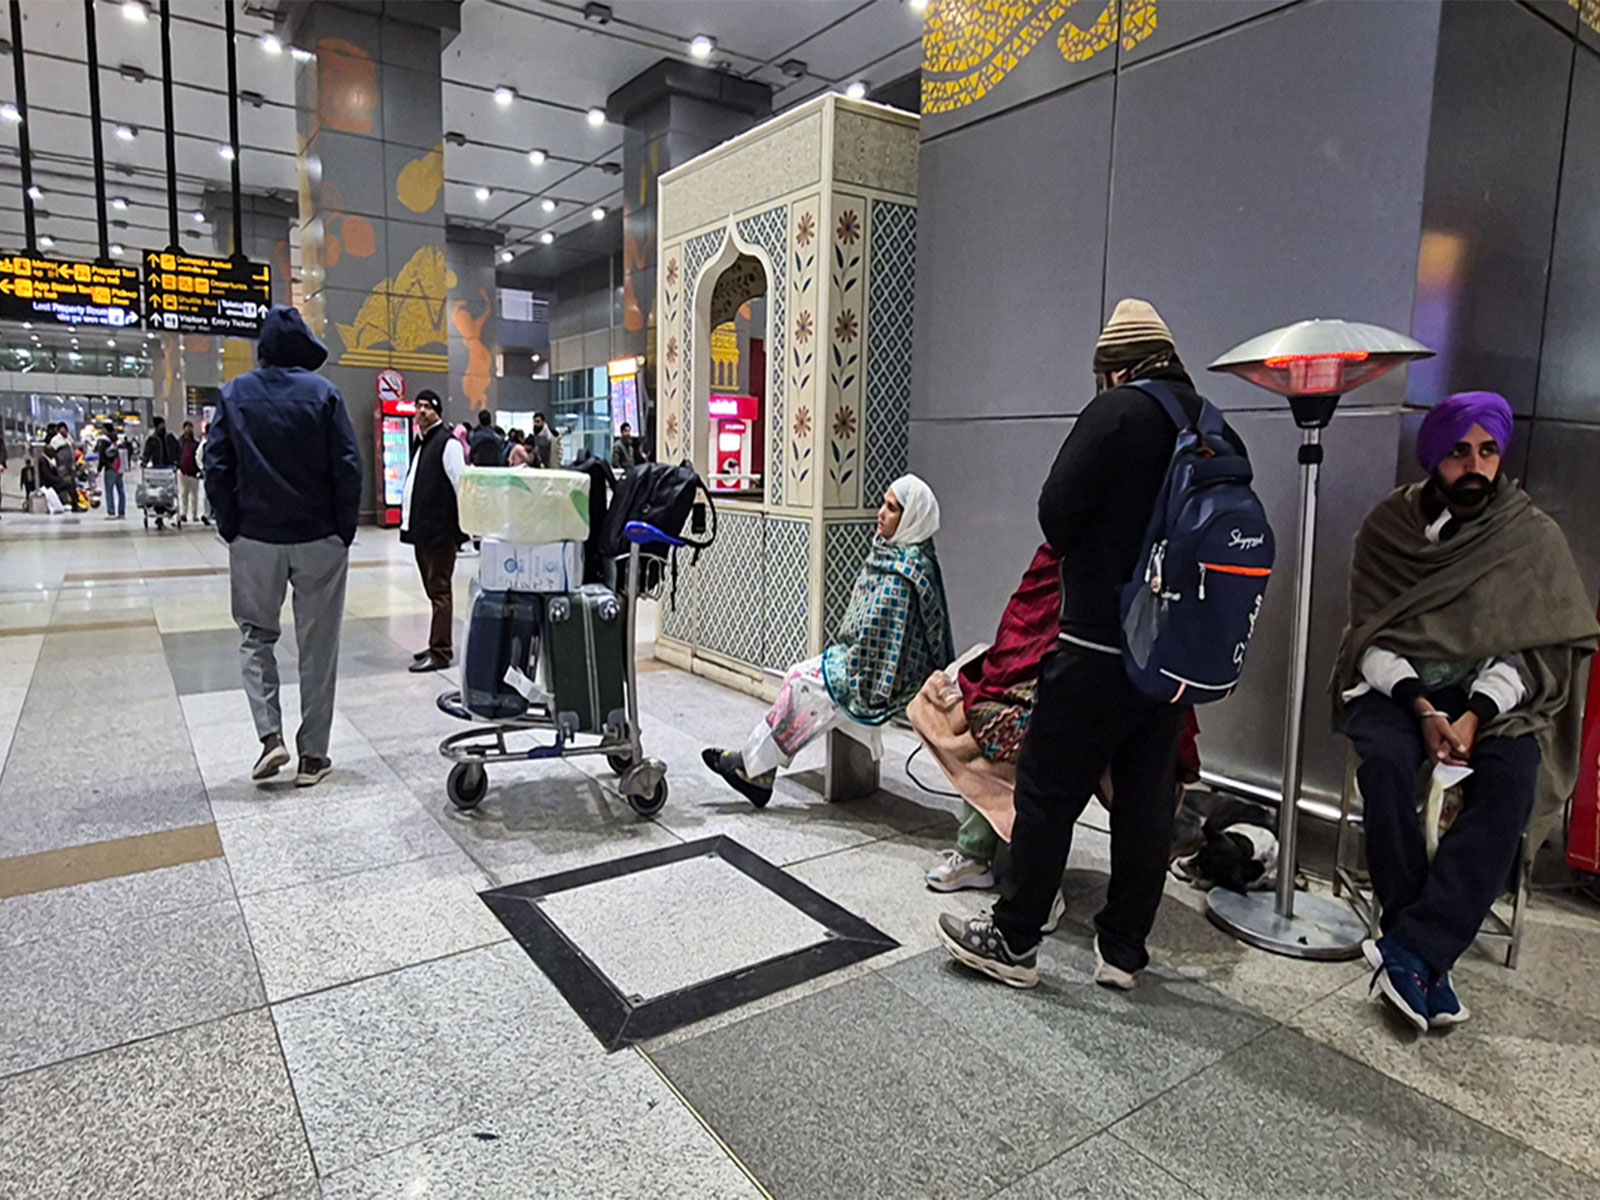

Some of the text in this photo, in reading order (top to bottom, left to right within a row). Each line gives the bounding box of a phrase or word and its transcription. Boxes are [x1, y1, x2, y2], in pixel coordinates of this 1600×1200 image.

[178, 295, 217, 306] Shuttle Bus
[32, 301, 108, 316] Lost Property Room
[179, 314, 207, 325] Visitors
[211, 317, 230, 328] Entry
[230, 319, 257, 329] Tickets
